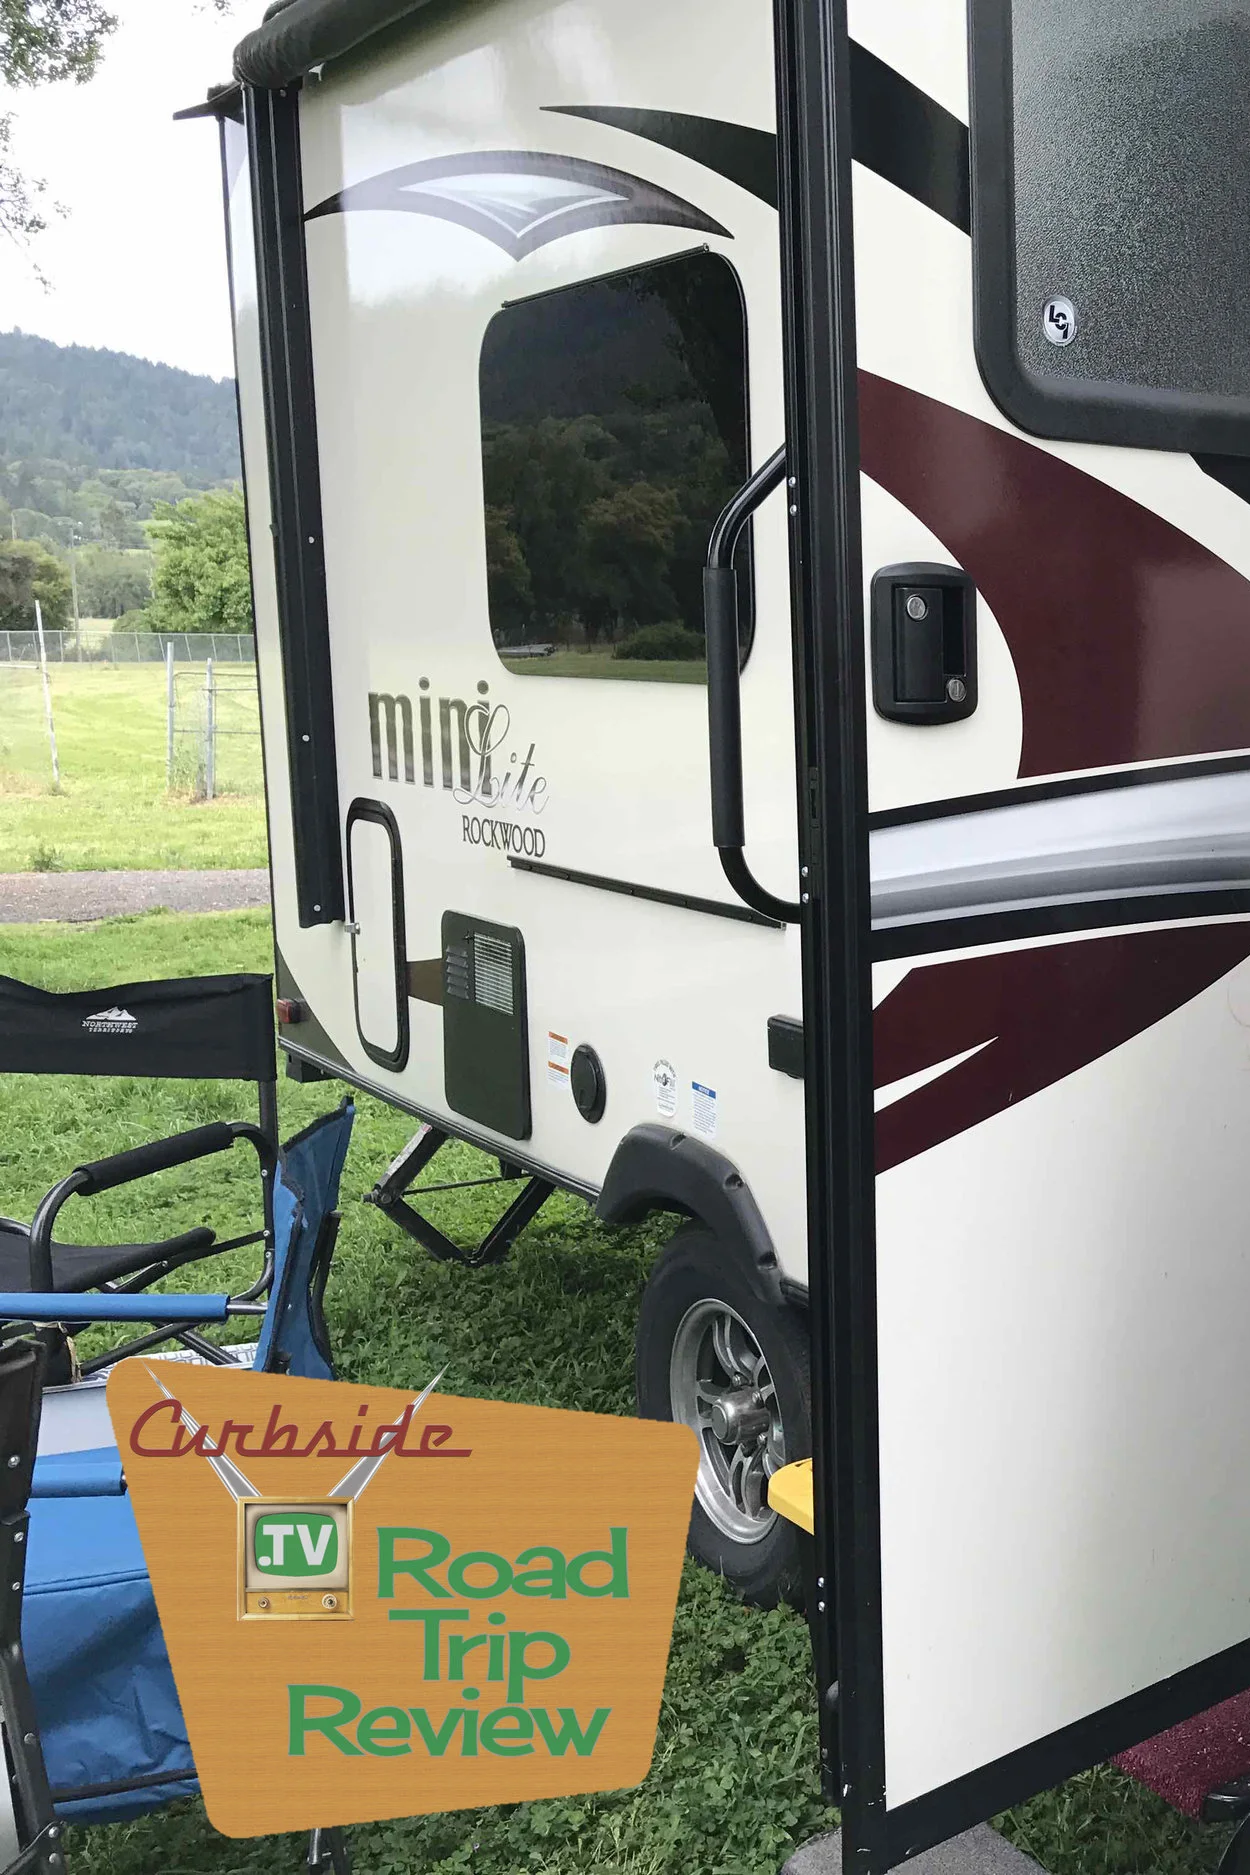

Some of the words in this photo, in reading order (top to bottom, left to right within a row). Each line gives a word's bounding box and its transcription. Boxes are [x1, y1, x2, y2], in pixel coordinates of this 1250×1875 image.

[368, 676, 493, 798] mini
[452, 703, 550, 816] Lite
[461, 814, 547, 859] ROCKWOOD
[81, 1020, 139, 1029] NORTHWEST
